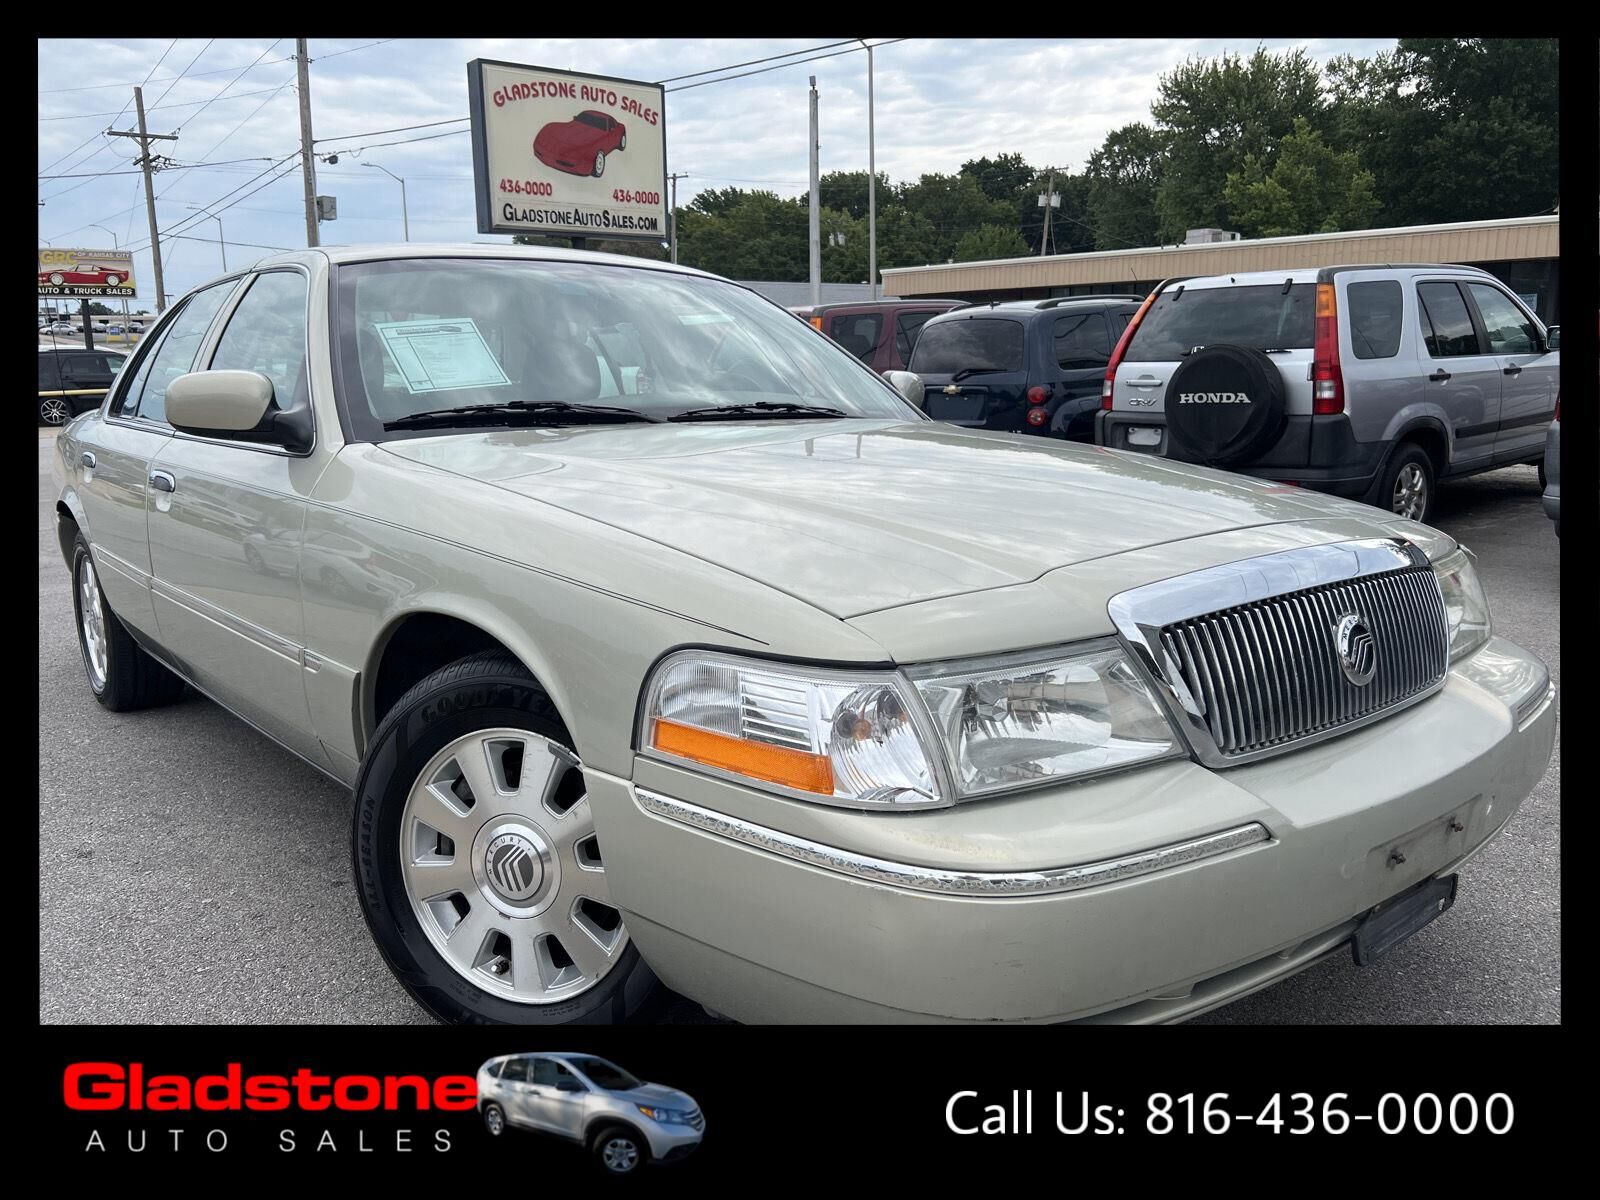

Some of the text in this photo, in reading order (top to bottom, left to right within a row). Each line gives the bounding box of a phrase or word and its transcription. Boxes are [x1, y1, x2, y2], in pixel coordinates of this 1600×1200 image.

[493, 81, 659, 126] GLADSTONE AUTO SALES
[499, 178, 553, 196] 436-0000
[612, 189, 660, 205] 436-0000
[40, 250, 77, 264] GRC
[106, 287, 133, 295] SALES
[1179, 392, 1251, 404] HONDA
[487, 836, 523, 875] MERCURY
